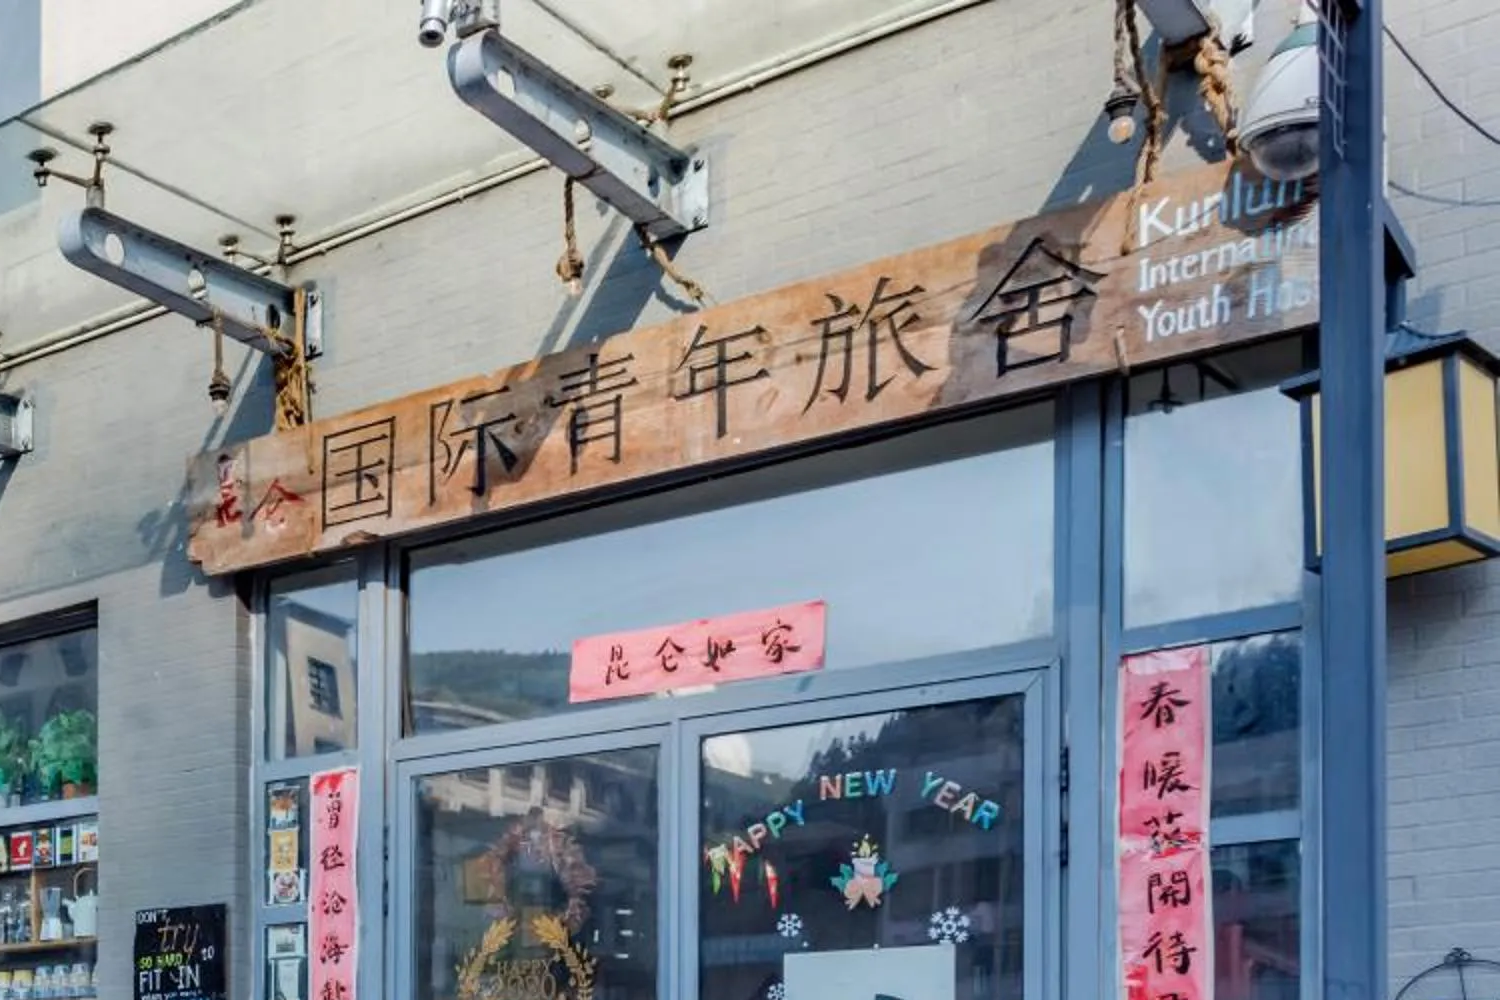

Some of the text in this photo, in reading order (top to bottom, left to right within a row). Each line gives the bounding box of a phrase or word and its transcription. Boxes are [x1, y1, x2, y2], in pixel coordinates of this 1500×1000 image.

[1137, 283, 1232, 342] Youth
[819, 768, 897, 801] NEW
[918, 770, 1001, 830] YEAR
[139, 963, 201, 993] FIT IN
